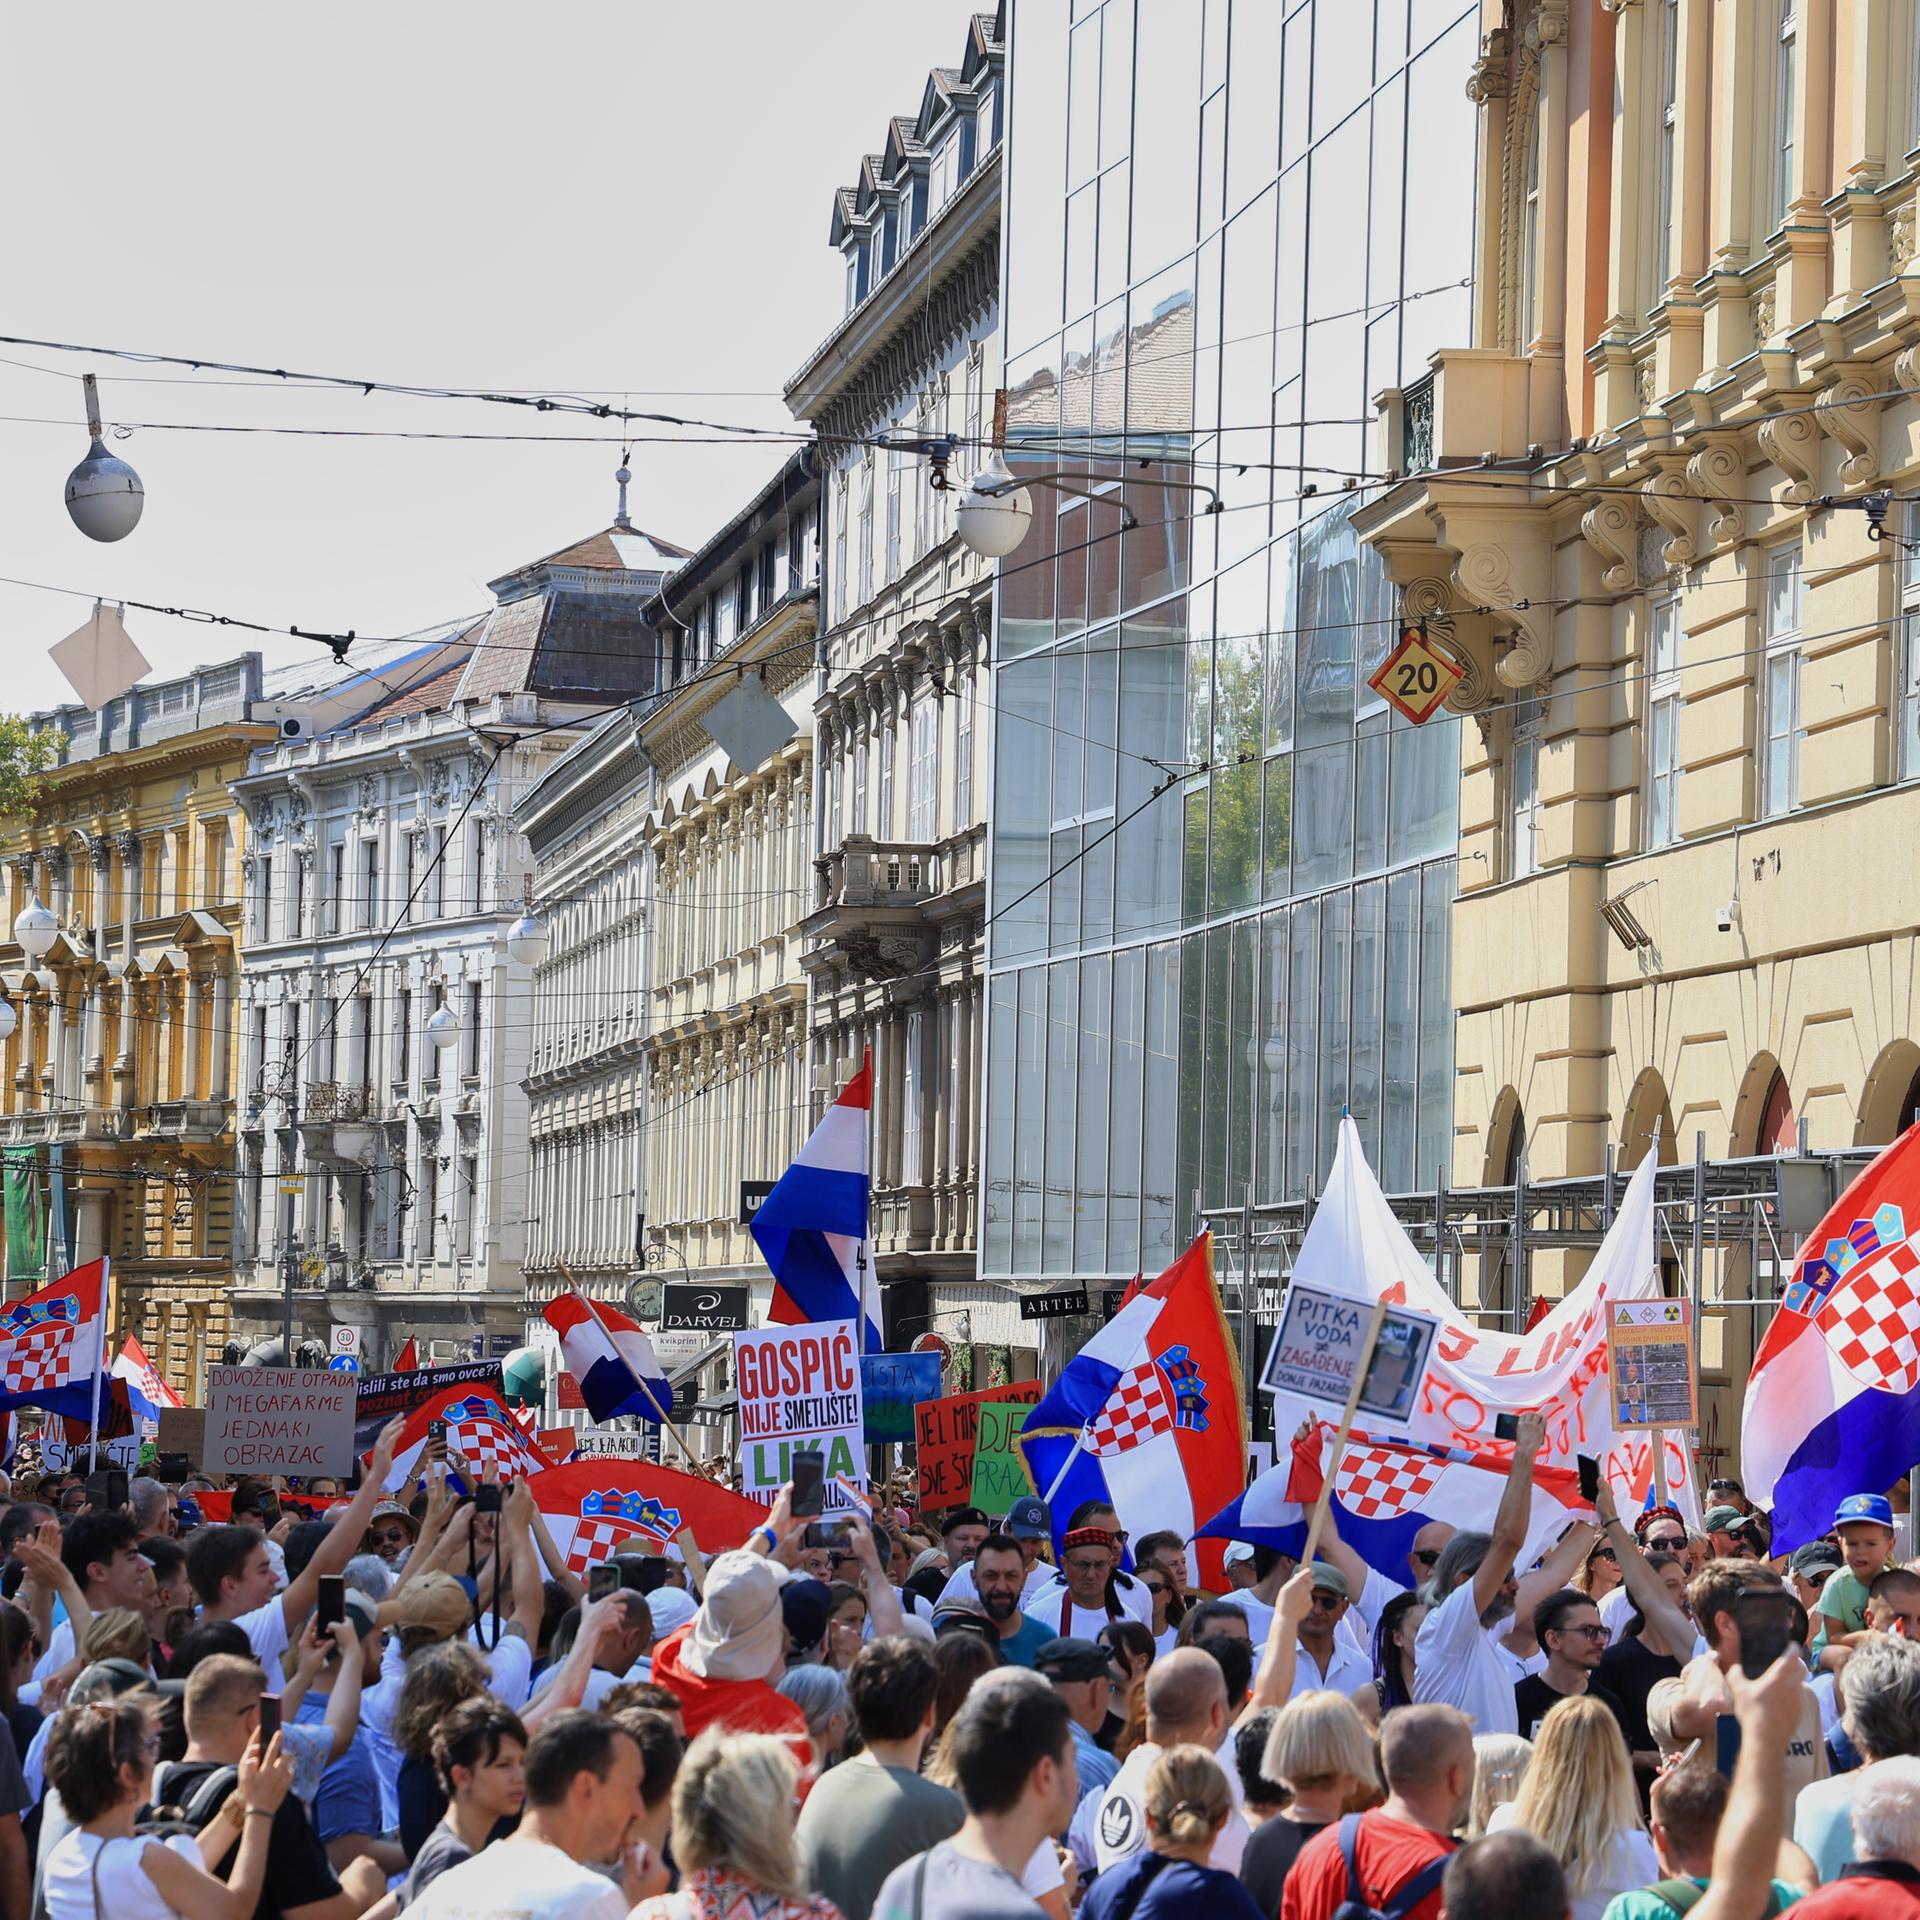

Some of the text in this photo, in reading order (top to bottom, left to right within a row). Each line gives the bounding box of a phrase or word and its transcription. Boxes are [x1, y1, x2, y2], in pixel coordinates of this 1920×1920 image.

[1397, 661, 1438, 696] 20
[1026, 1296, 1085, 1313] ARTEE
[1297, 1297, 1360, 1331] PITKA
[667, 1314, 743, 1328] DARVEL
[340, 1332, 351, 1342] 30
[660, 1336, 698, 1346] kvikprint
[1304, 1321, 1352, 1346] VODA
[738, 1325, 854, 1400] GOSPIĆ
[212, 1368, 355, 1389] DOVOŽENJE OTPADA
[356, 1362, 501, 1396] islili ste da smo ovce??
[1276, 1370, 1306, 1388] DONJE
[211, 1394, 344, 1413] I MEGAFARME
[742, 1392, 859, 1434] NIJE SMETLIŠTE!
[219, 1419, 311, 1439] JEDNAKI
[224, 1443, 325, 1466] OBRAZAC
[920, 1460, 949, 1496] SVE
